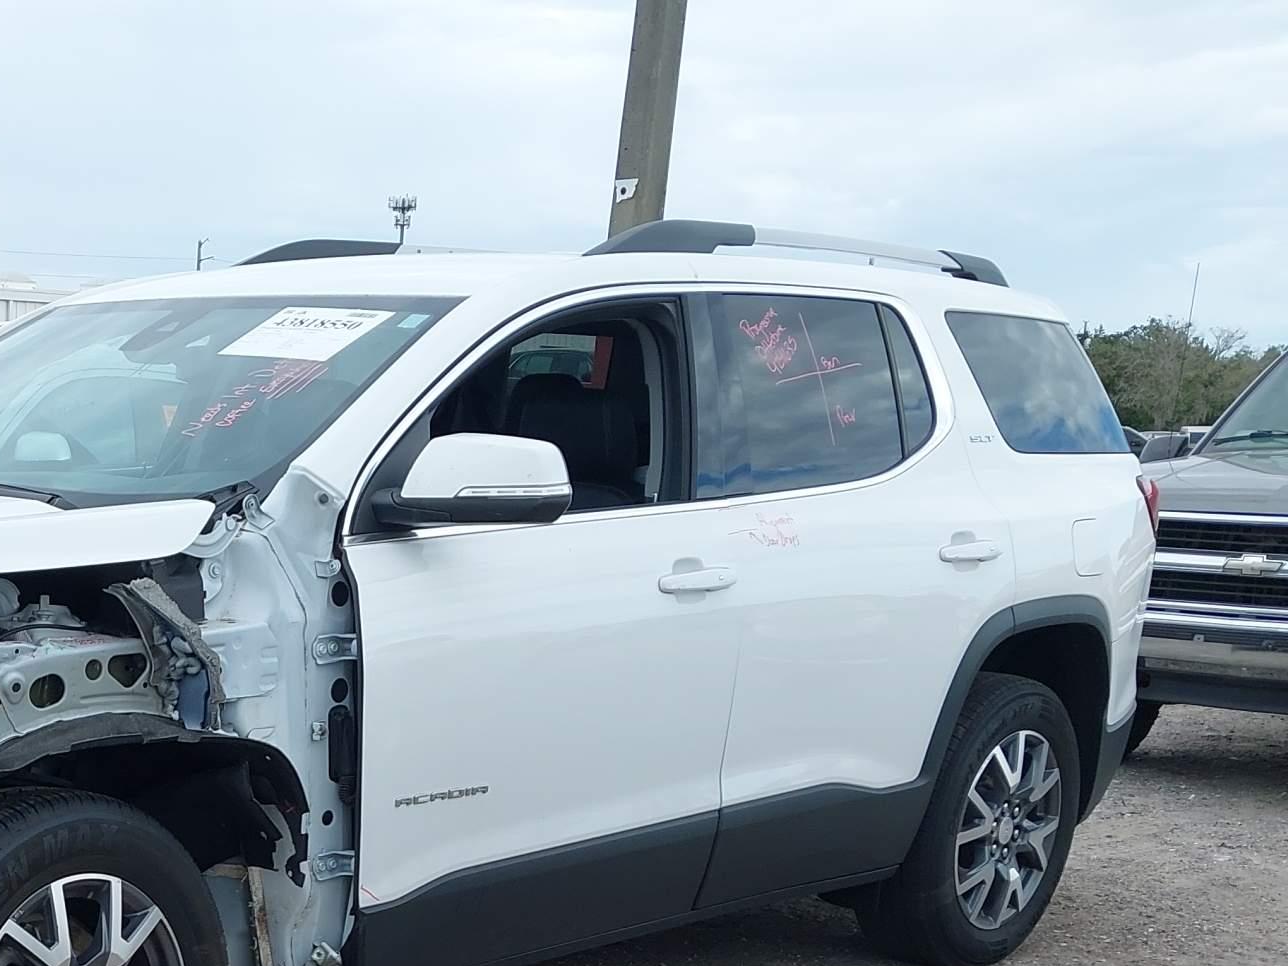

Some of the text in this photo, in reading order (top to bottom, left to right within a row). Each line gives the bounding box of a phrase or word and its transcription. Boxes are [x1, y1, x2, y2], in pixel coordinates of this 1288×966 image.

[272, 317, 365, 331] 43818550
[969, 434, 996, 443] SLT
[394, 785, 489, 808] ACADIA
